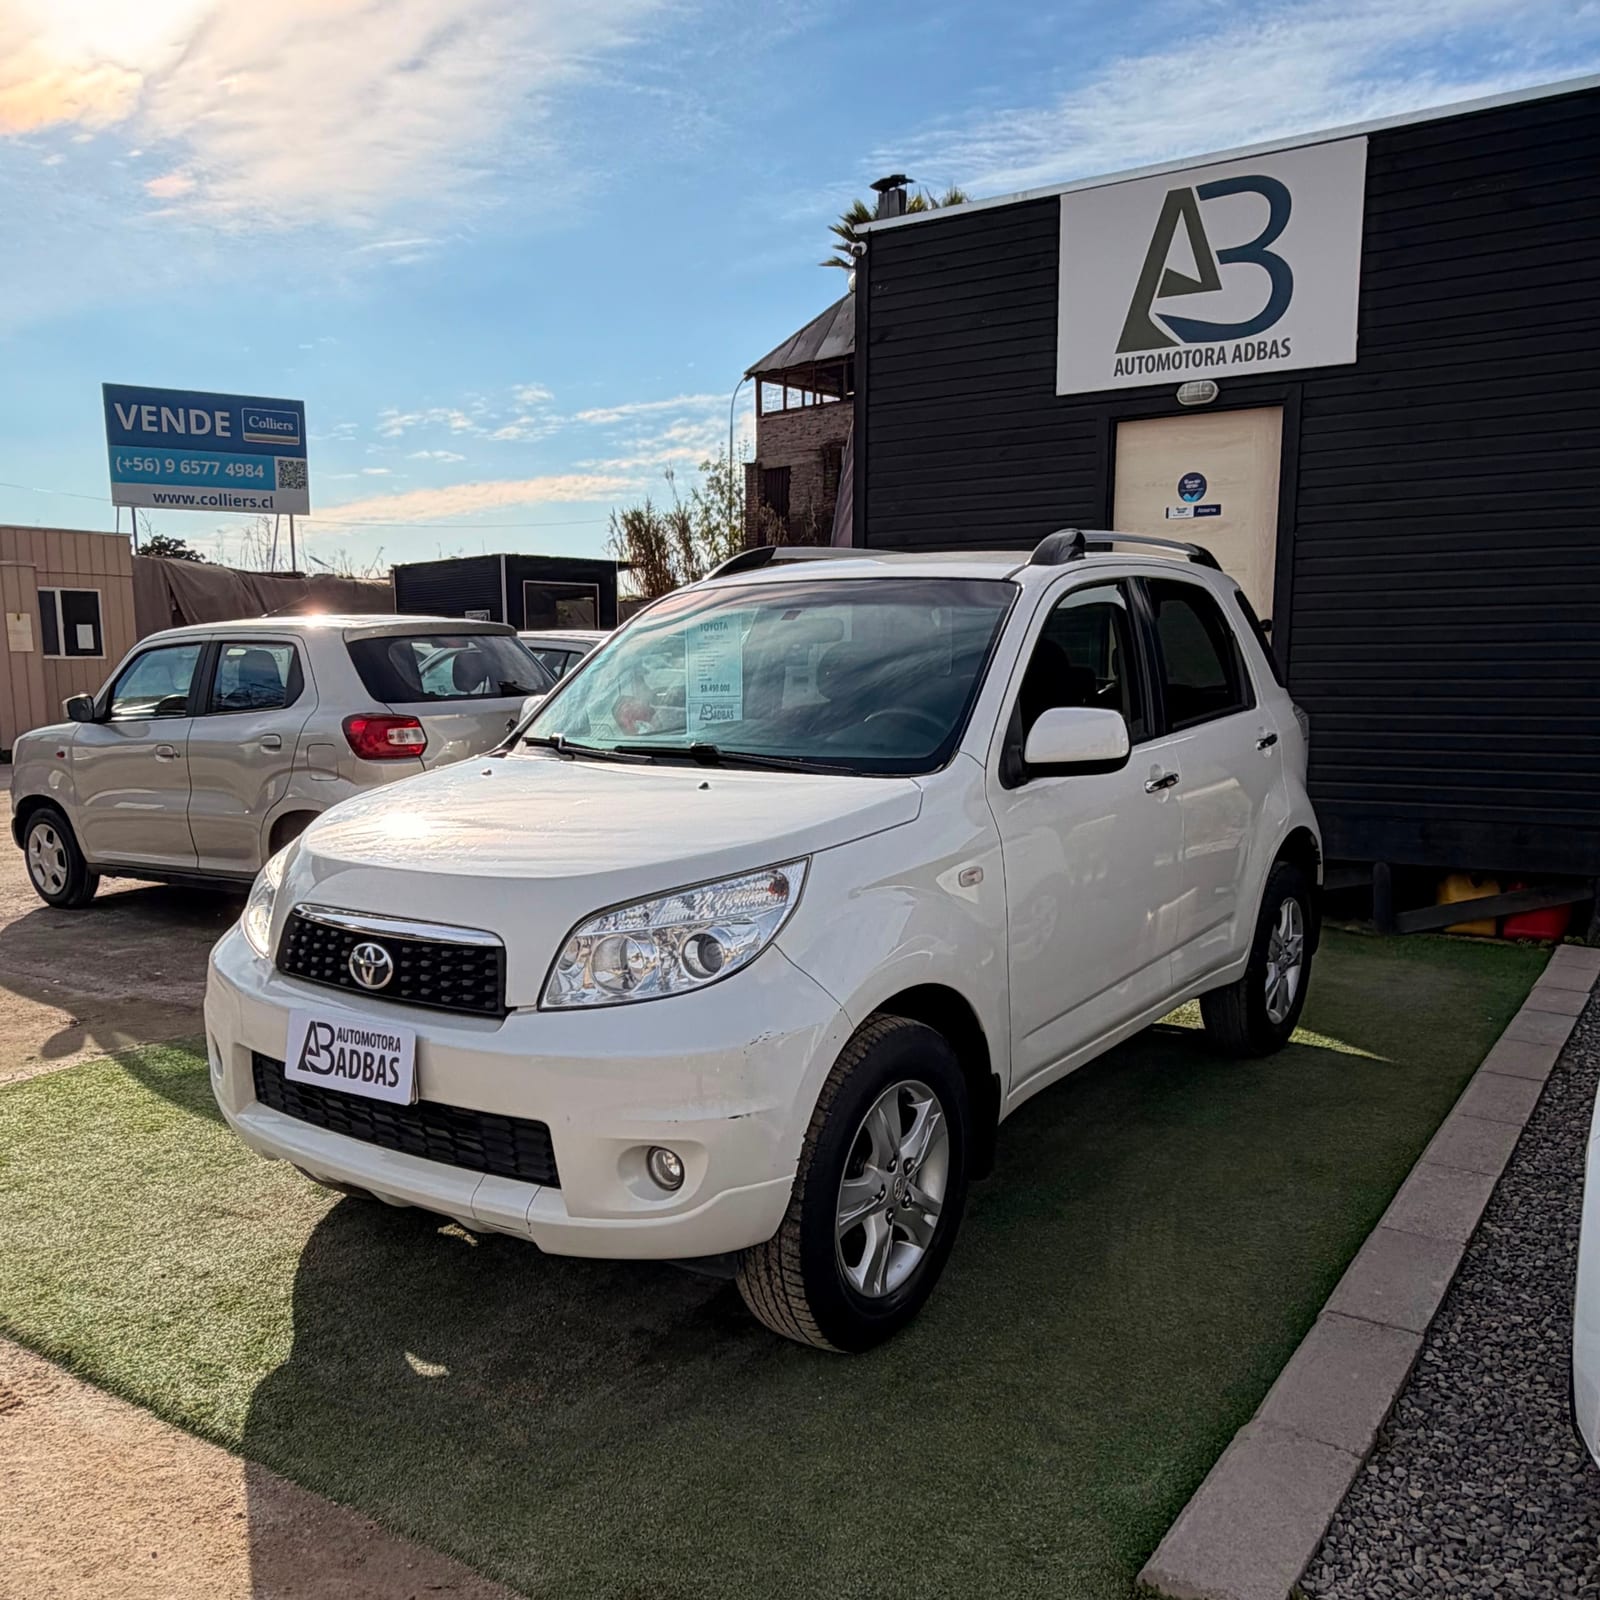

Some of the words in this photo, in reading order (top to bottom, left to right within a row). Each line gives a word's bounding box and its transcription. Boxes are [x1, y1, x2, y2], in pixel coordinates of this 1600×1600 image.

[1113, 345, 1228, 378] AUTOMOTORA
[1231, 337, 1292, 364] ADBAS
[114, 402, 232, 438] VENDE
[248, 415, 294, 431] Colliers
[115, 456, 160, 475] (+56)
[165, 459, 175, 474] 9
[180, 459, 220, 476] 6577
[225, 463, 265, 479] 4984
[152, 491, 274, 509] www.colliers.cl
[699, 623, 729, 632] TOYOTA
[336, 1027, 401, 1053] AUTOMOTORA
[335, 1047, 400, 1088] ADBAS
